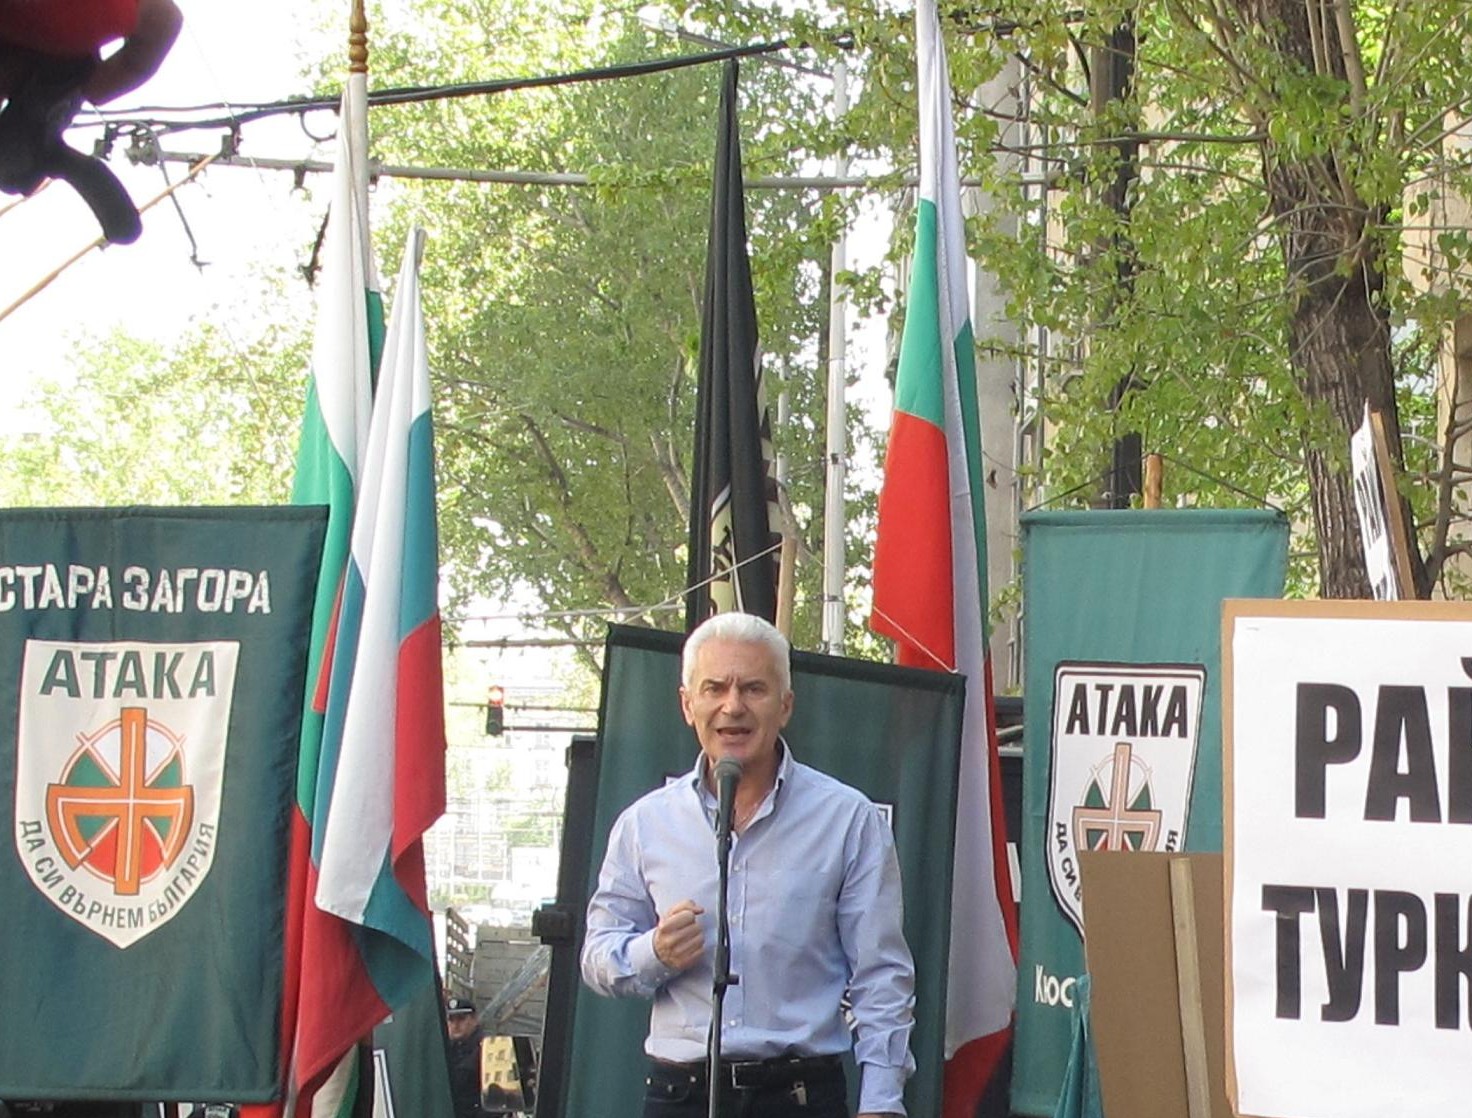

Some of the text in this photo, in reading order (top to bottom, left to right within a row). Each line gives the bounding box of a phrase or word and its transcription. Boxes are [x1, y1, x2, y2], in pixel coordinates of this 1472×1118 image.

[0, 563, 271, 614] СТАРА ЗАГОРА
[39, 649, 216, 699] АТАКА
[1065, 682, 1188, 738] АТАКА
[20, 820, 215, 929] ДА СИ ВЪРНЕМ БЪЛГАРИЯ
